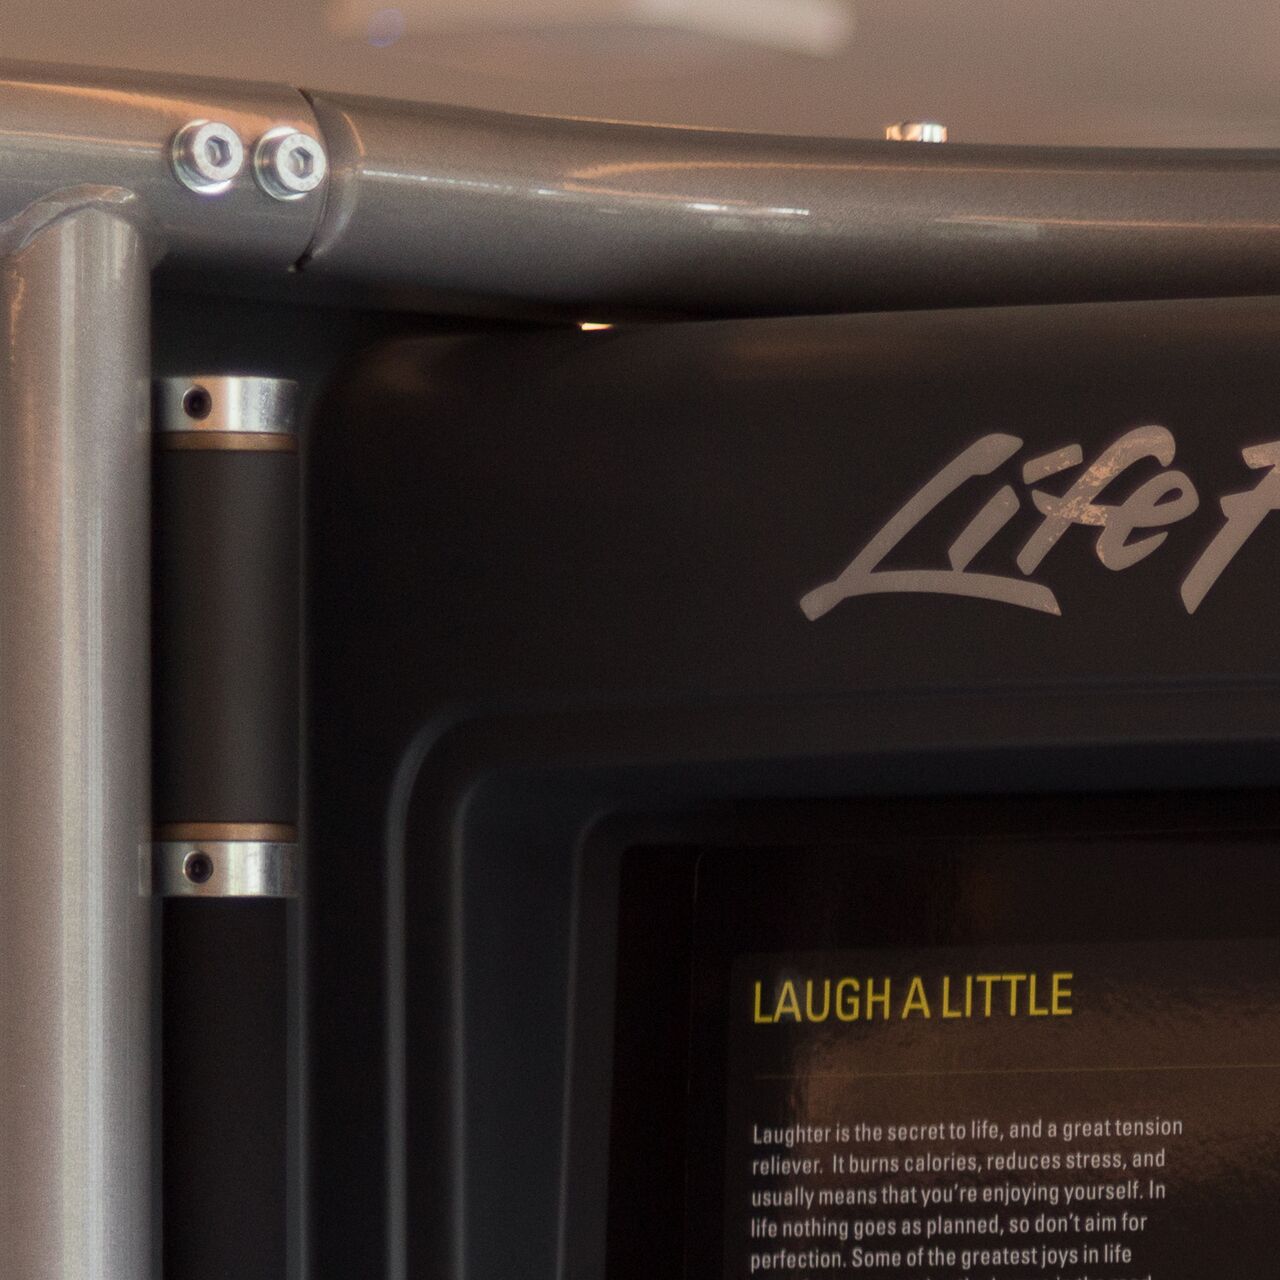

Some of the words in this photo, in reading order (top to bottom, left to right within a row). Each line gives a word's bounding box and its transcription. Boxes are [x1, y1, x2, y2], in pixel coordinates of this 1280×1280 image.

[801, 424, 1199, 620] Life
[753, 976, 891, 1024] LAUGH
[901, 976, 931, 1019] A
[942, 972, 1074, 1018] LITTLE
[753, 1123, 832, 1148] Laughter
[835, 1123, 850, 1143] is
[854, 1122, 883, 1142] the
[887, 1122, 945, 1142] secret
[948, 1122, 967, 1140] to
[971, 1119, 1004, 1142] life,
[1009, 1118, 1042, 1139] and
[1047, 1122, 1057, 1138] a
[1062, 1119, 1112, 1142] great
[1114, 1116, 1183, 1137] tension
[752, 1155, 823, 1176] reliever.
[832, 1154, 845, 1174] It
[849, 1153, 900, 1174] burns
[904, 1152, 982, 1173] calories,
[987, 1150, 1061, 1171] reduces
[1065, 1151, 1127, 1171] stress,
[1132, 1147, 1166, 1168] and
[751, 1186, 815, 1210] usually
[818, 1189, 878, 1205] means
[881, 1184, 917, 1204] that
[982, 1182, 1059, 1206] enjoying
[1063, 1179, 1144, 1205] yourself.
[1149, 1179, 1166, 1199] In
[751, 1217, 778, 1238] life
[782, 1217, 849, 1241] nothing
[853, 1220, 897, 1241] goes
[901, 1220, 922, 1236] as
[926, 1213, 1005, 1240] planned,
[1009, 1218, 1030, 1234] so
[1084, 1212, 1117, 1233] aim
[1121, 1211, 1148, 1232] for
[750, 1249, 847, 1274] perfection.
[851, 1247, 902, 1268] Some
[906, 1246, 924, 1267] of
[927, 1246, 957, 1267] the
[961, 1247, 1038, 1270] greatest
[1041, 1245, 1079, 1269] joys
[1083, 1244, 1099, 1264] in
[1104, 1243, 1132, 1264] life
